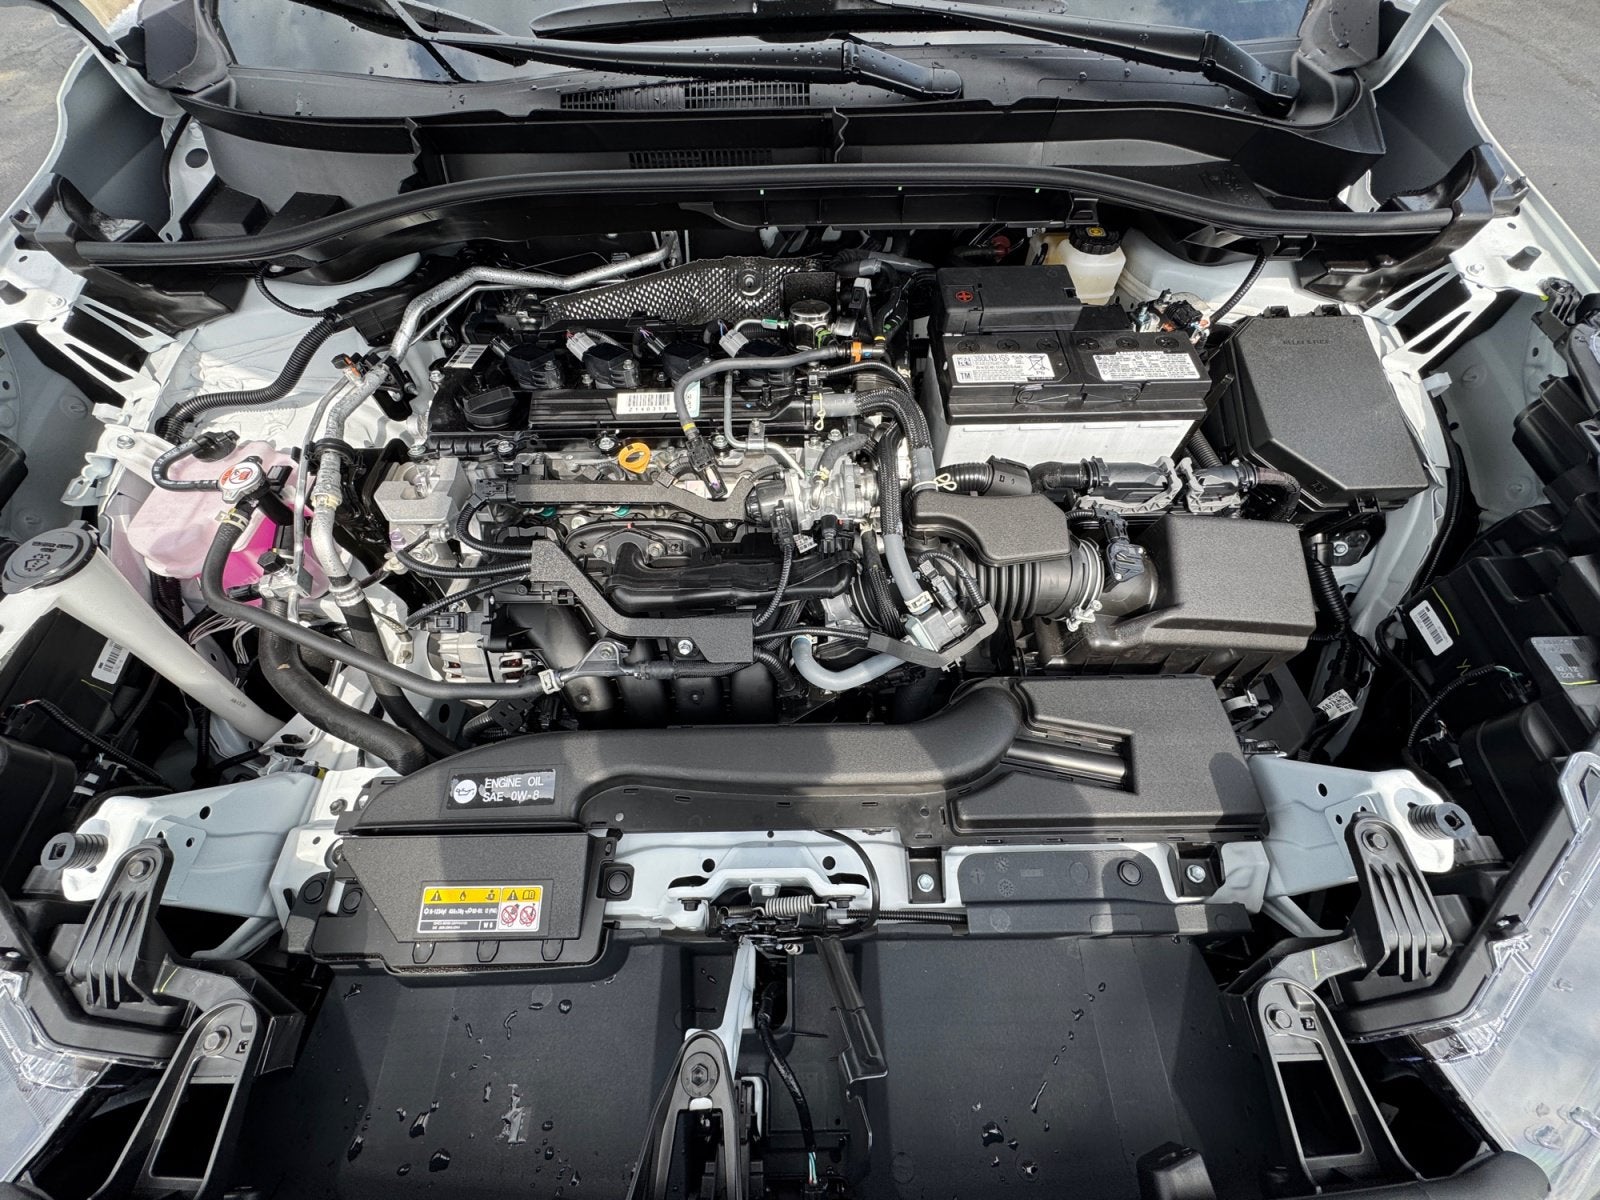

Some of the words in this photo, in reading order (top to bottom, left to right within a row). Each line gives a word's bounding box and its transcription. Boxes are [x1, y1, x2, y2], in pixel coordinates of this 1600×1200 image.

[960, 372, 971, 380] TM
[484, 778, 522, 789] ENGINE
[527, 776, 545, 787] OIL
[482, 792, 504, 802] SAE
[510, 789, 540, 801] 0W-8
